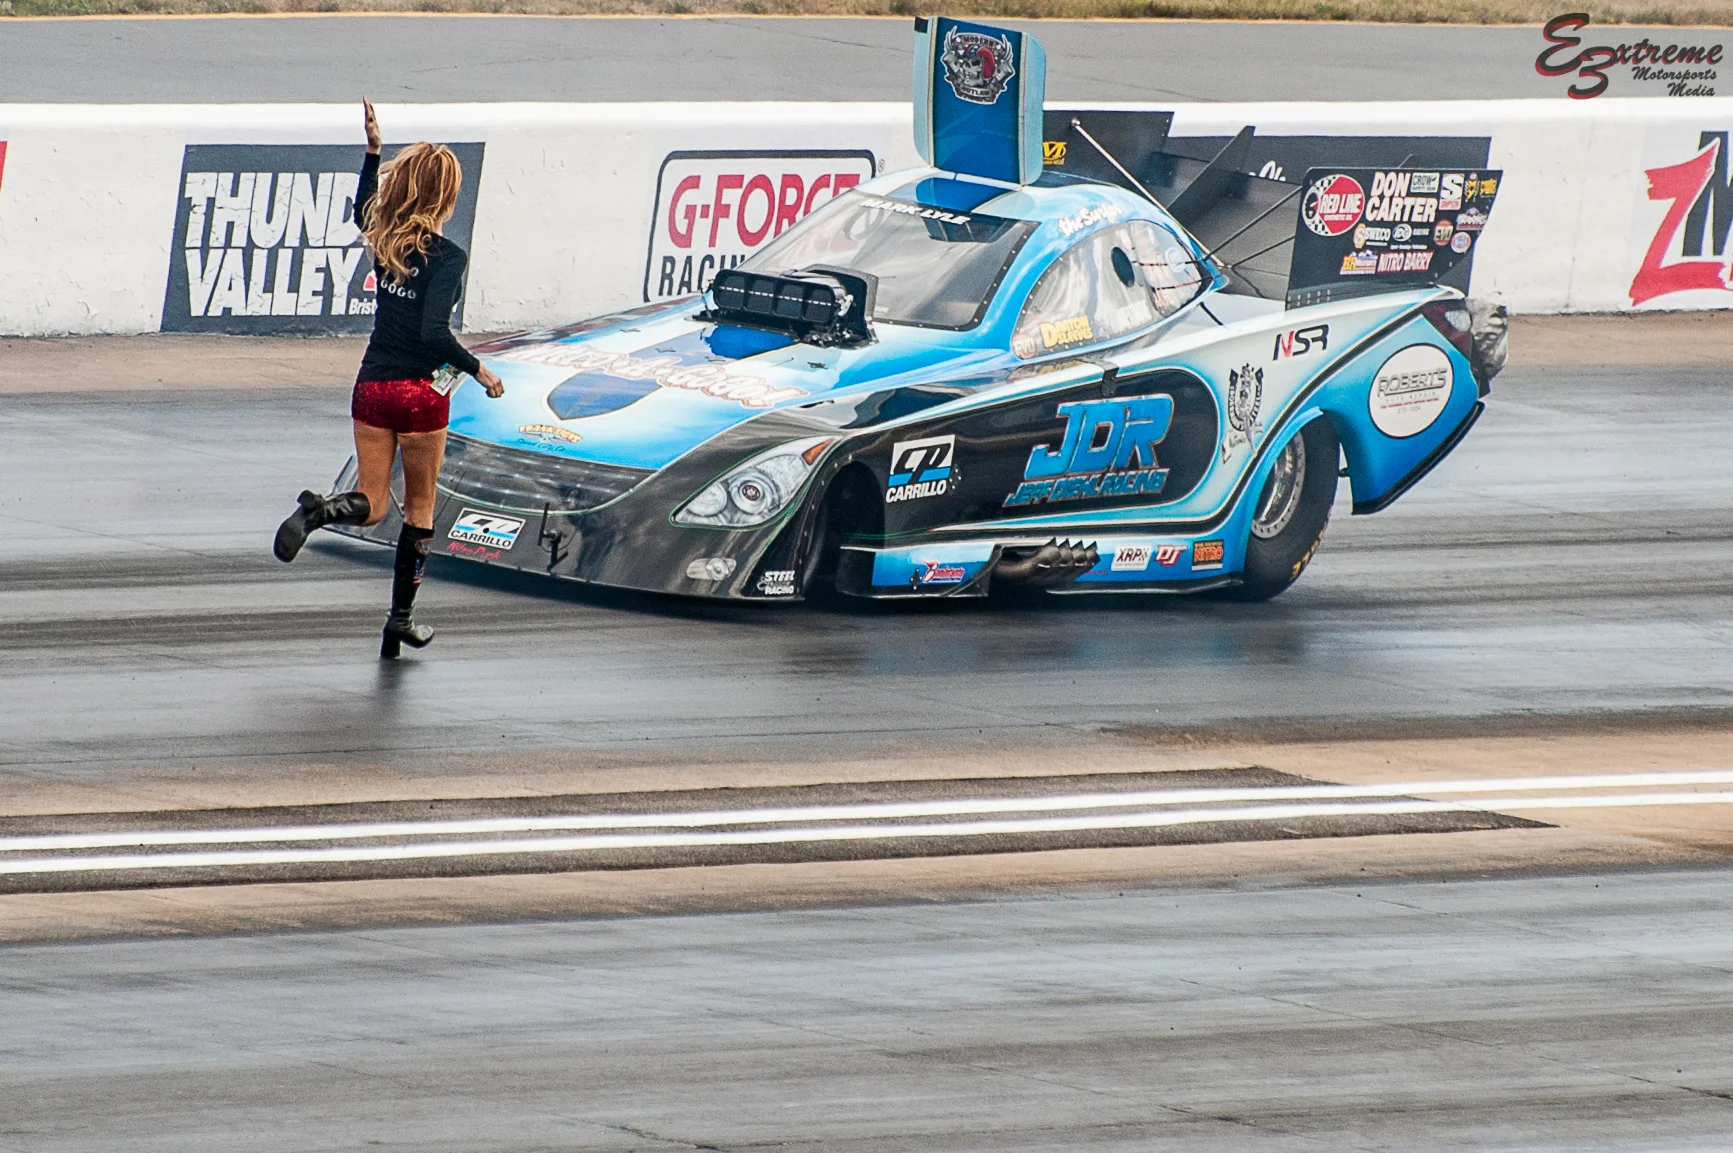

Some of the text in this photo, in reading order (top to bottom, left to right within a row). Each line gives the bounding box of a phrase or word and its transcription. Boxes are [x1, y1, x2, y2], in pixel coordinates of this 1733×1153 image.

[1371, 172, 1411, 197] DON
[185, 172, 364, 248] THUND
[860, 199, 971, 225] MARK LYLE
[1320, 193, 1362, 214] RED LINE
[1365, 197, 1437, 222] CARTER
[1378, 252, 1405, 272] NITRO
[1404, 252, 1434, 271] BARRY
[185, 248, 364, 317] VALLEY
[380, 279, 416, 299] GOGO
[349, 298, 378, 315] Brist
[1272, 324, 1329, 361] NSR
[1024, 393, 1175, 481] JDR
[886, 478, 948, 504] CARRILLO
[1002, 479, 1054, 508] JEFF
[1099, 467, 1171, 496] RACING
[450, 530, 511, 548] CARRILLO
[1116, 548, 1143, 562] XRP
[1193, 546, 1224, 563] NITRO
[764, 570, 795, 582] STEEL
[764, 585, 795, 595] RACING
